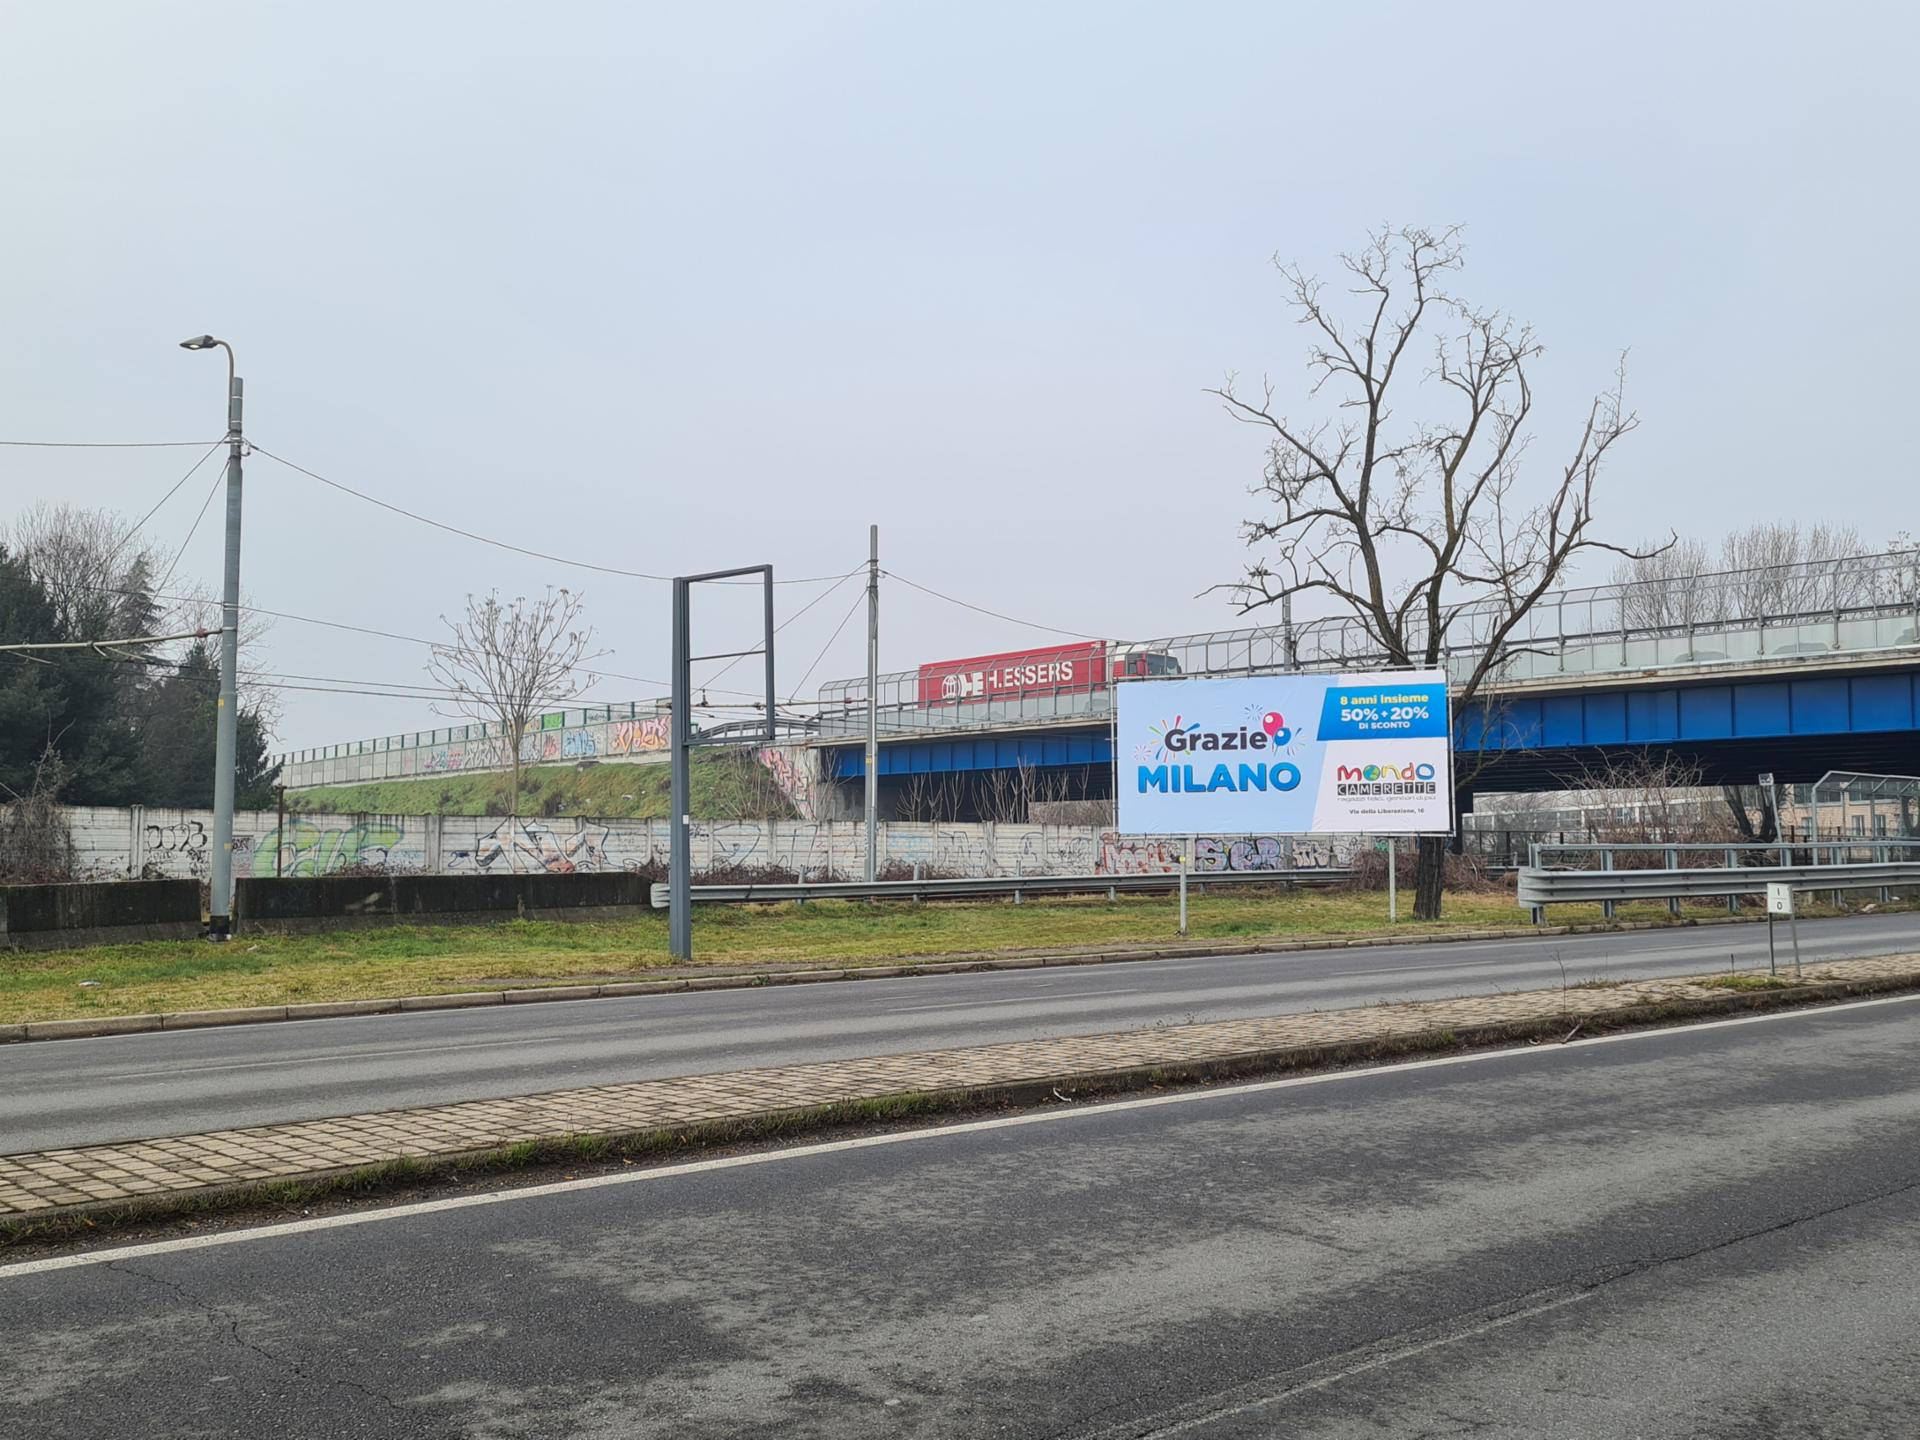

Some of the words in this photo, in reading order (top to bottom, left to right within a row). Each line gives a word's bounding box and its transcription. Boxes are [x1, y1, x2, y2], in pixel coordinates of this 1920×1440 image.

[1340, 696, 1348, 705] 8
[1351, 695, 1377, 705] anni
[1341, 708, 1379, 721] 50%
[1390, 706, 1429, 720] 20%
[1358, 722, 1369, 730] DI
[1371, 721, 1411, 730] SCONTO
[1164, 726, 1268, 752] Grazie
[1138, 762, 1302, 793] MILANO
[1337, 782, 1436, 795] CAMERETTE
